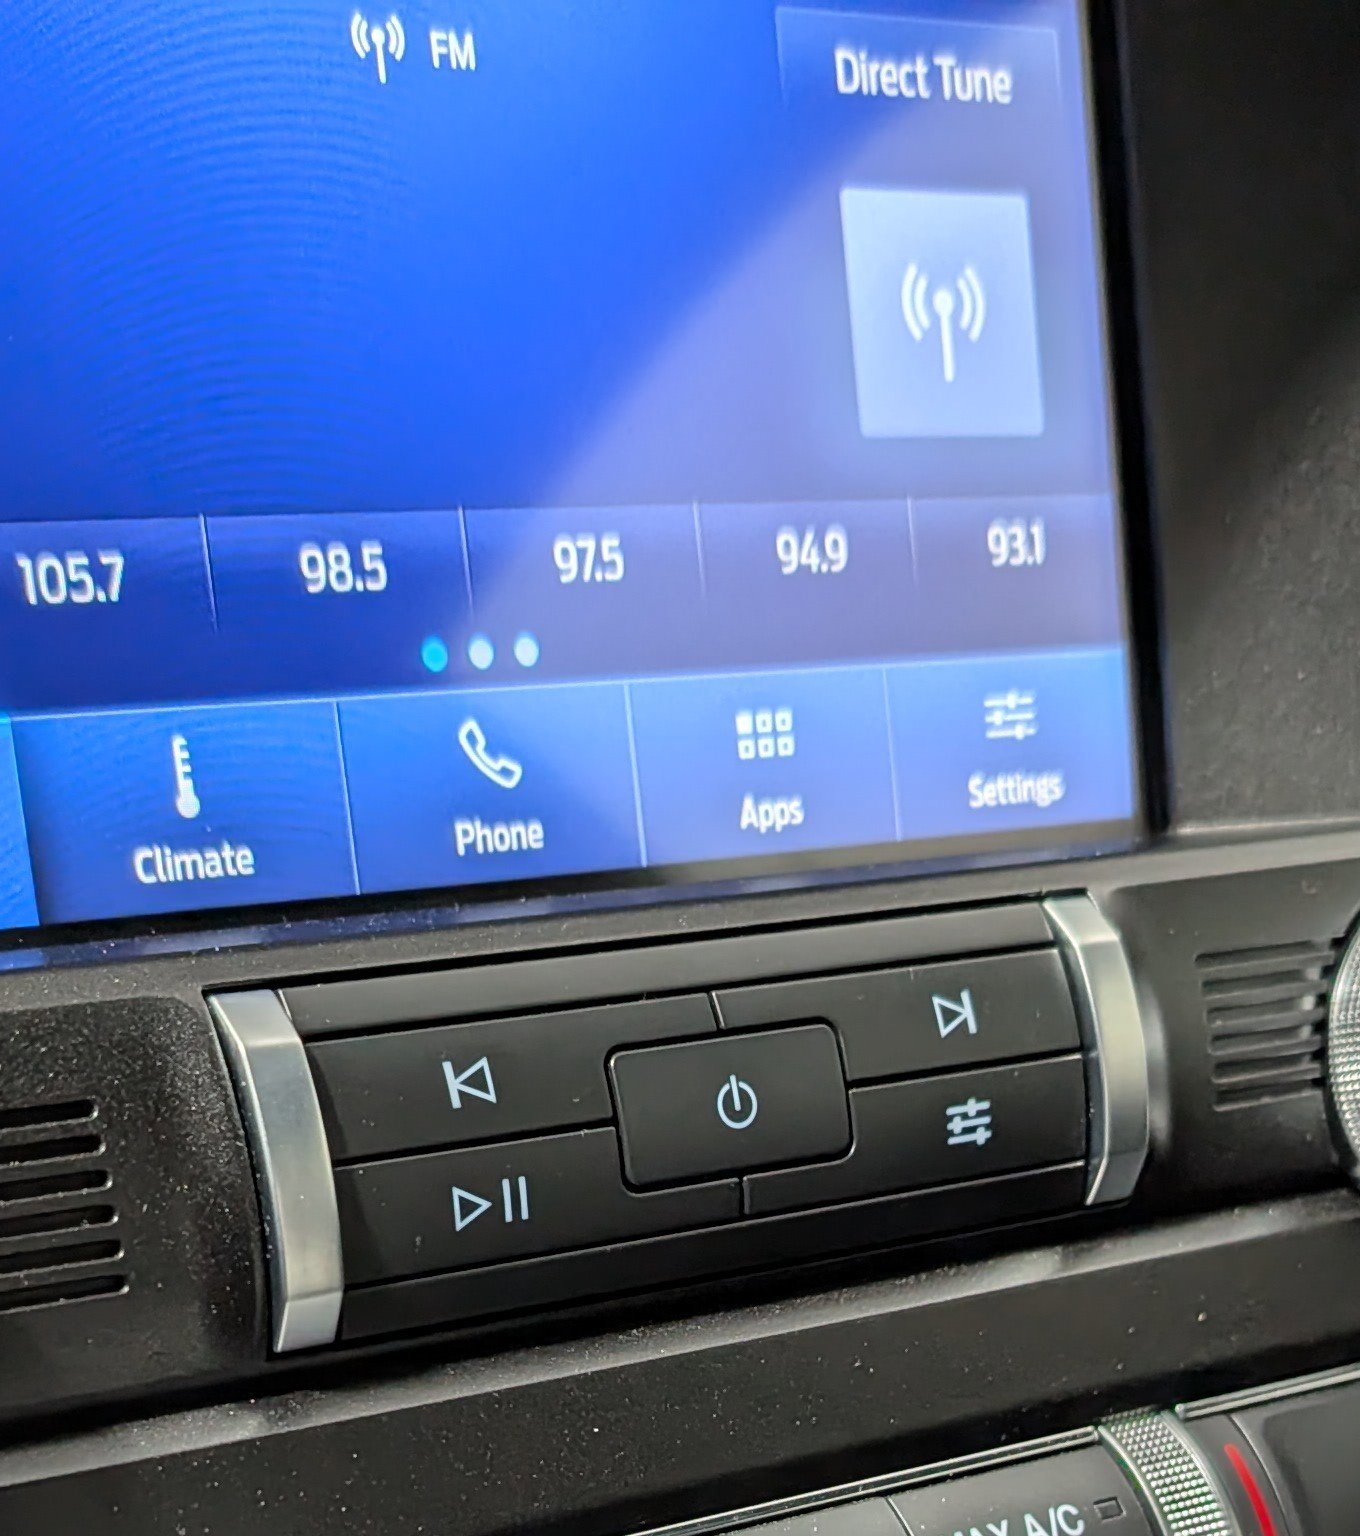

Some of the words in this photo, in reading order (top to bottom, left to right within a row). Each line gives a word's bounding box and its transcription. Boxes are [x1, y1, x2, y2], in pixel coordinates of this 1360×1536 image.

[430, 31, 477, 71] FM
[835, 47, 931, 99] Direct
[934, 54, 1014, 104] Tune
[298, 541, 388, 593] 98.5
[553, 533, 625, 583] 97.5
[776, 525, 849, 575] 94.9
[986, 519, 1046, 567] 93.1
[16, 550, 126, 606] 105.7
[739, 793, 805, 834] Apps
[967, 770, 1065, 809] Settings
[455, 815, 544, 857] Phone
[134, 841, 255, 885] Climate
